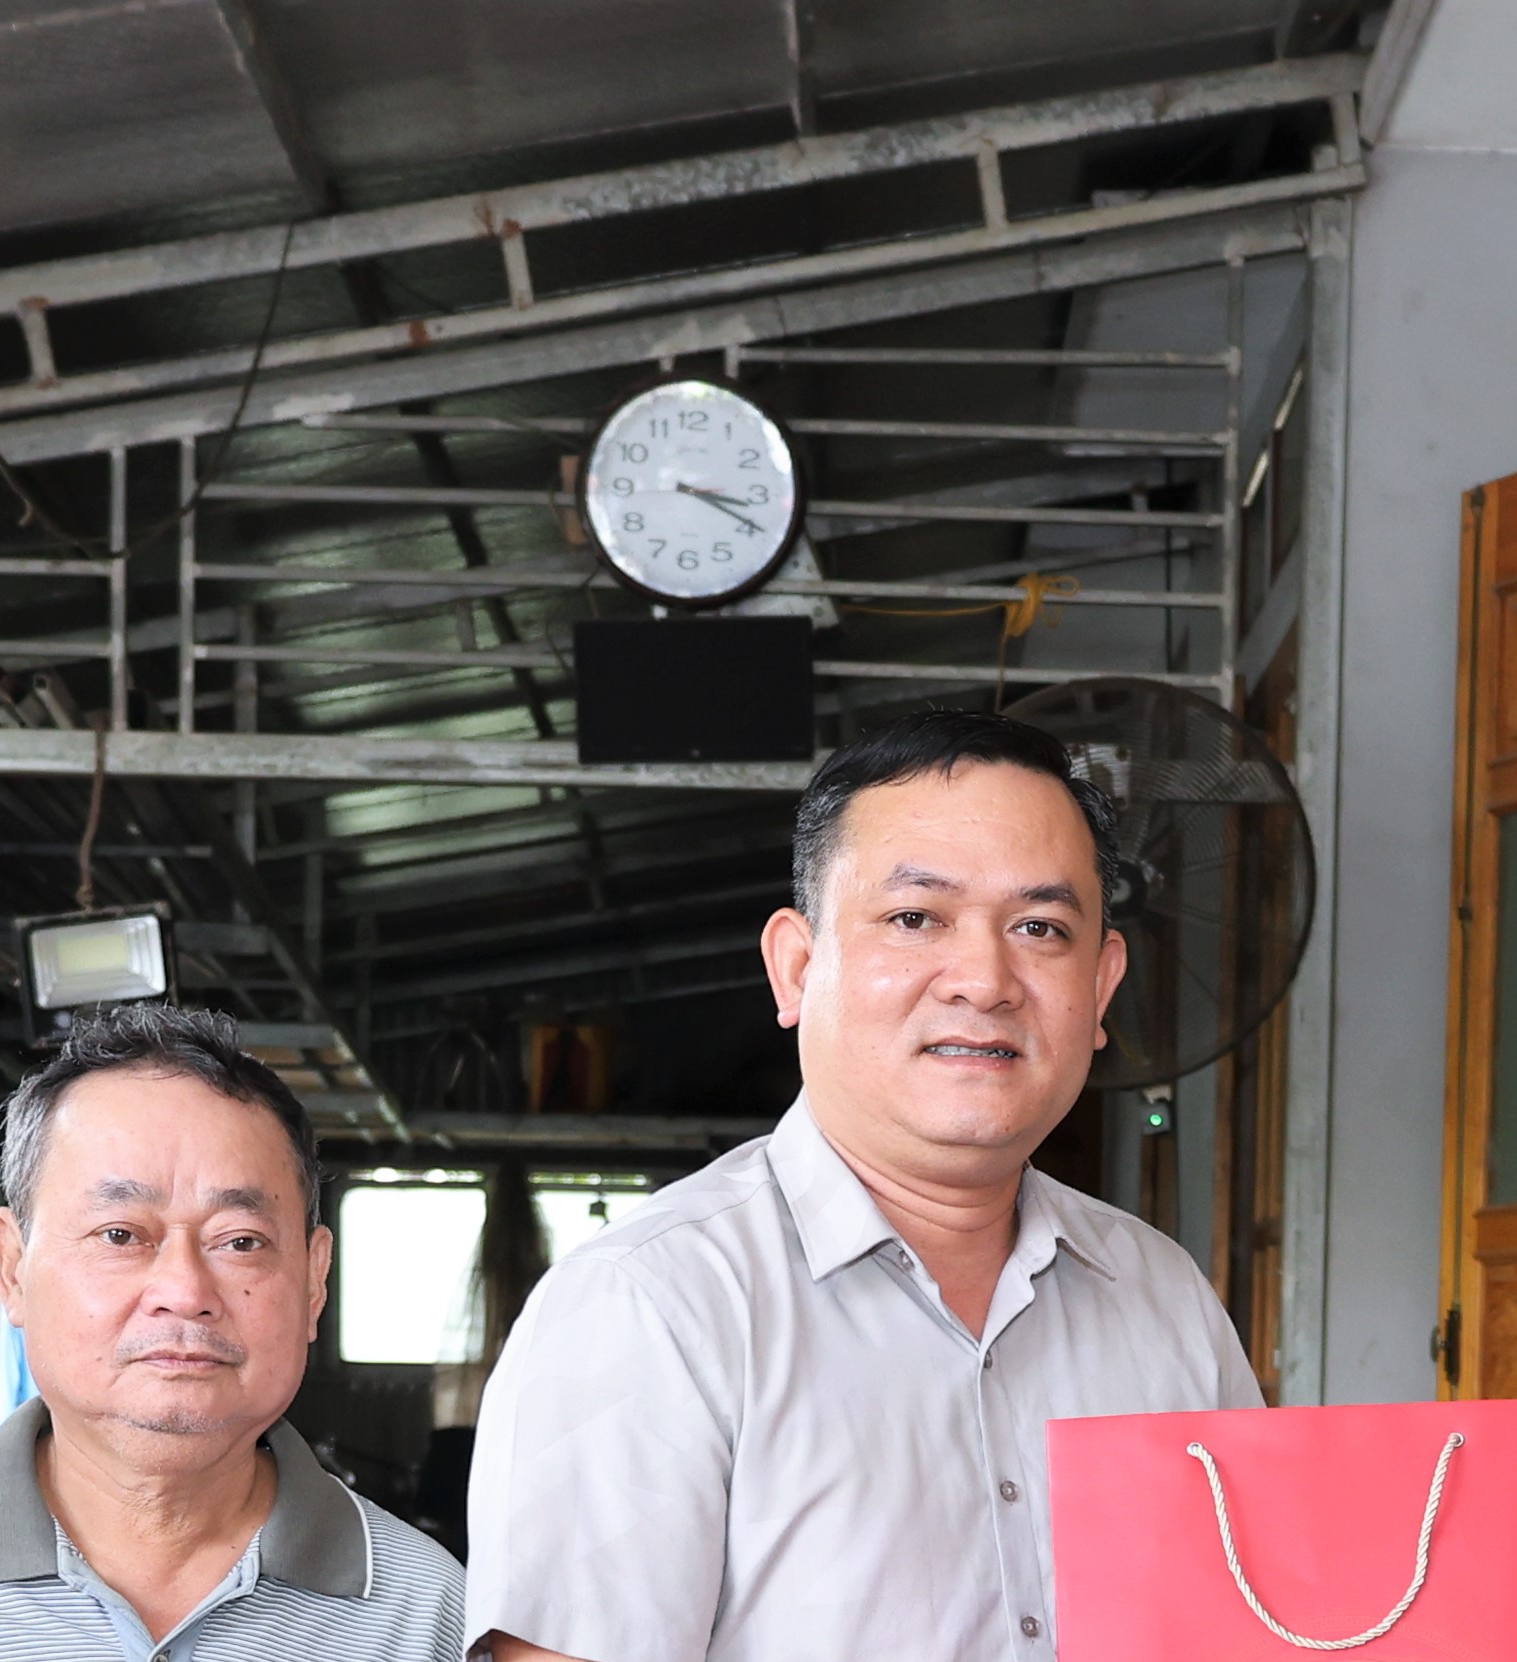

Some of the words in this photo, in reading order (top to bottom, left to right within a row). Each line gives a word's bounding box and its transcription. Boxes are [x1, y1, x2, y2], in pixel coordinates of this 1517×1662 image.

[649, 418, 669, 438] 11
[678, 411, 709, 432] 12
[724, 422, 732, 440] 1
[617, 442, 648, 464] 10
[737, 448, 760, 469] 2
[612, 477, 635, 497] 9
[747, 484, 770, 505] 3
[623, 511, 645, 533] 8
[736, 519, 756, 539] 4
[647, 538, 668, 559] 7
[711, 542, 733, 562] 5
[677, 550, 699, 571] 6
